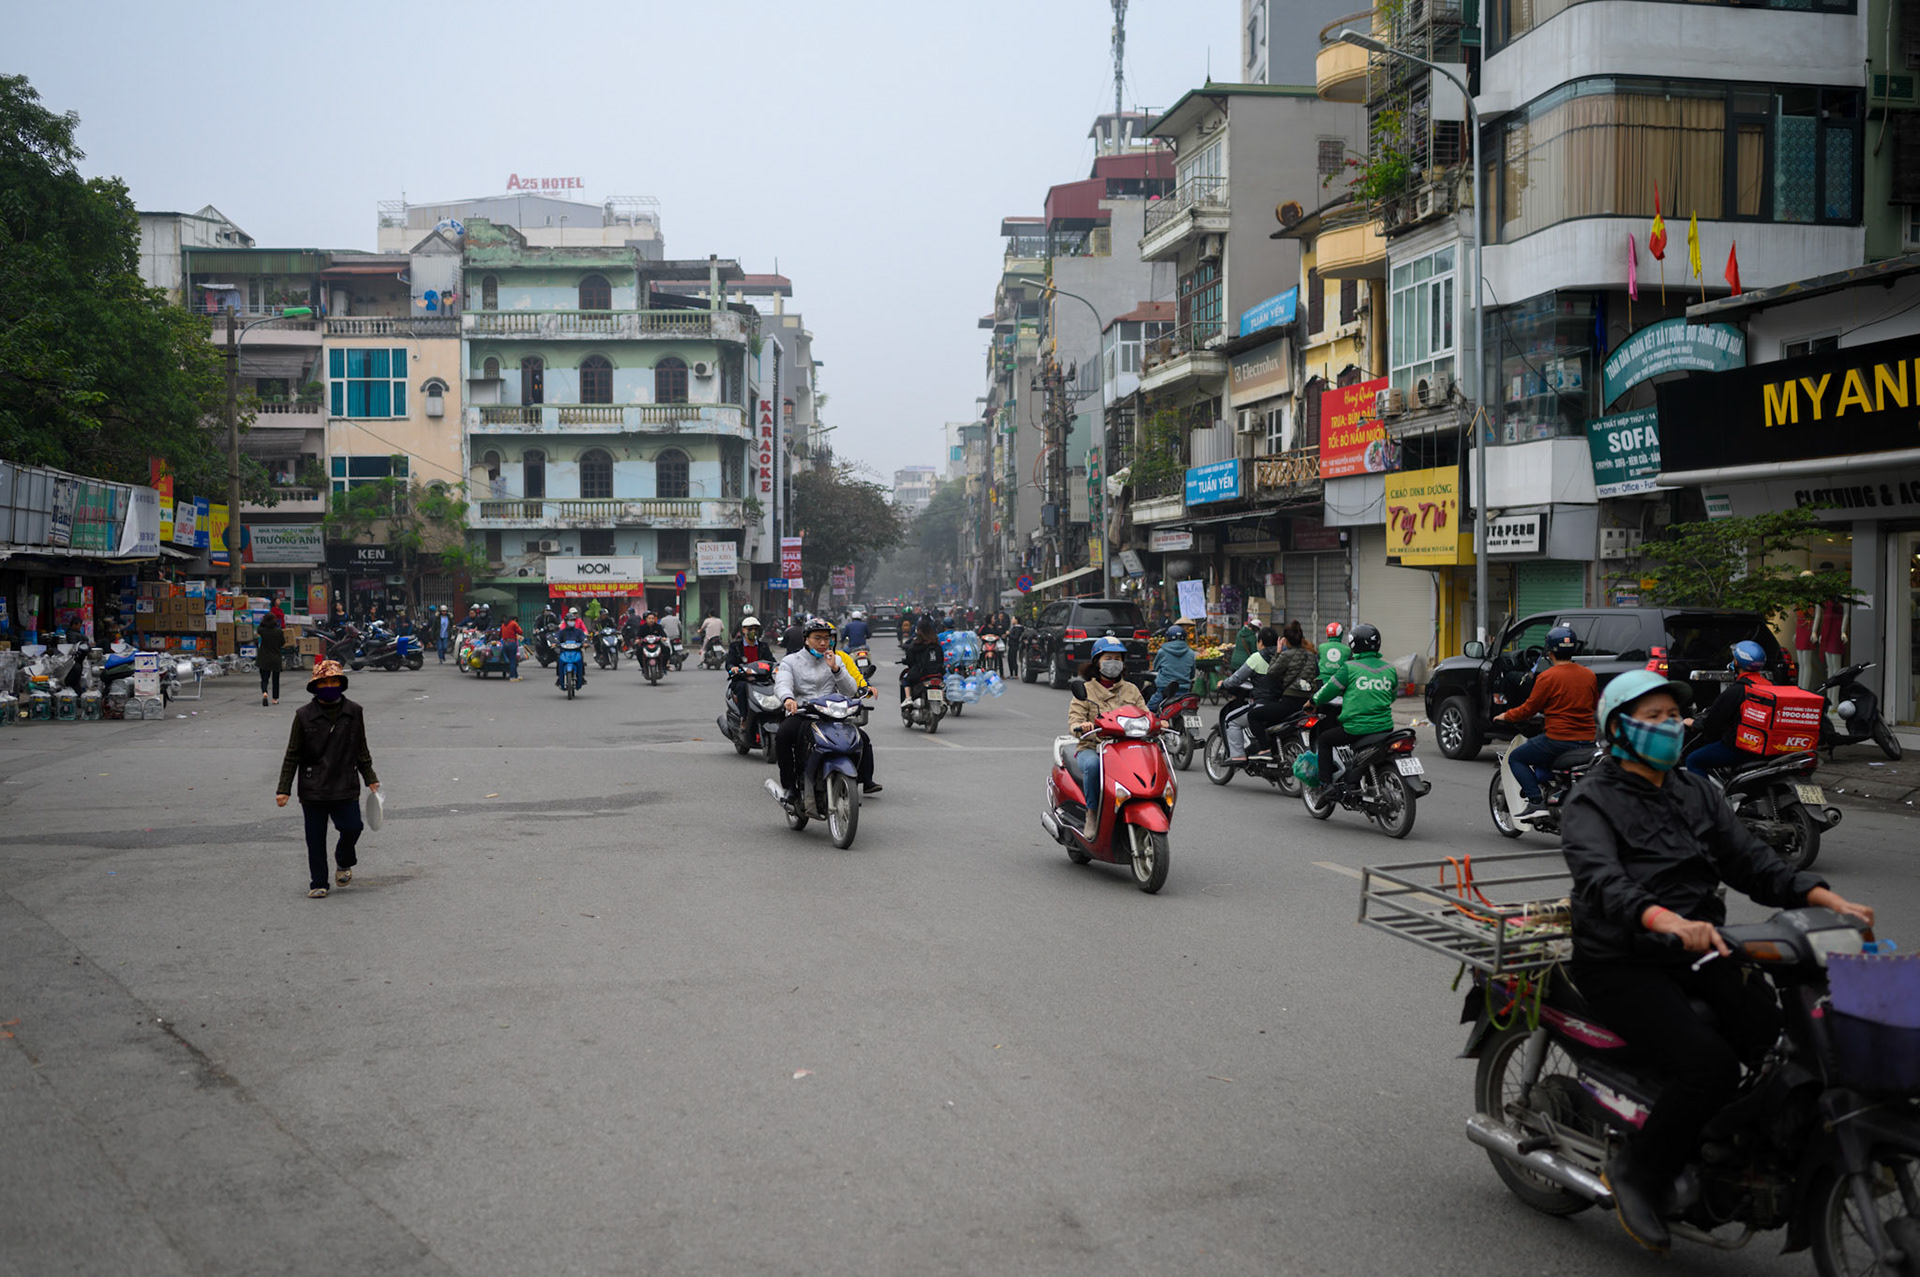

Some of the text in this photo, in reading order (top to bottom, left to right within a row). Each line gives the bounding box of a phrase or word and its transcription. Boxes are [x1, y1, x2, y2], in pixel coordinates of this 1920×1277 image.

[507, 173, 584, 190] A25 HOTEL
[1271, 302, 1285, 319] YẾN
[1242, 355, 1279, 380] Electrolux
[1763, 358, 1920, 428] MYAN
[1602, 419, 1617, 430] THẤT
[760, 400, 772, 492] KARAOKE
[1608, 426, 1659, 453] SOFA
[1198, 470, 1234, 494] TUẤN YẾN
[1410, 486, 1425, 497] DINH
[1427, 482, 1452, 495] DƯỠNG
[1599, 487, 1617, 496] Home
[1622, 483, 1640, 492] Office
[1795, 486, 1877, 508] CLOTHING
[1879, 484, 1895, 506] &
[254, 534, 321, 545] TRƯỜNG ANH
[358, 549, 385, 559] KEN
[577, 563, 610, 574] MOON
[1355, 676, 1392, 691] Grab
[1743, 732, 1760, 743] KFC
[1785, 736, 1811, 747] KFC
